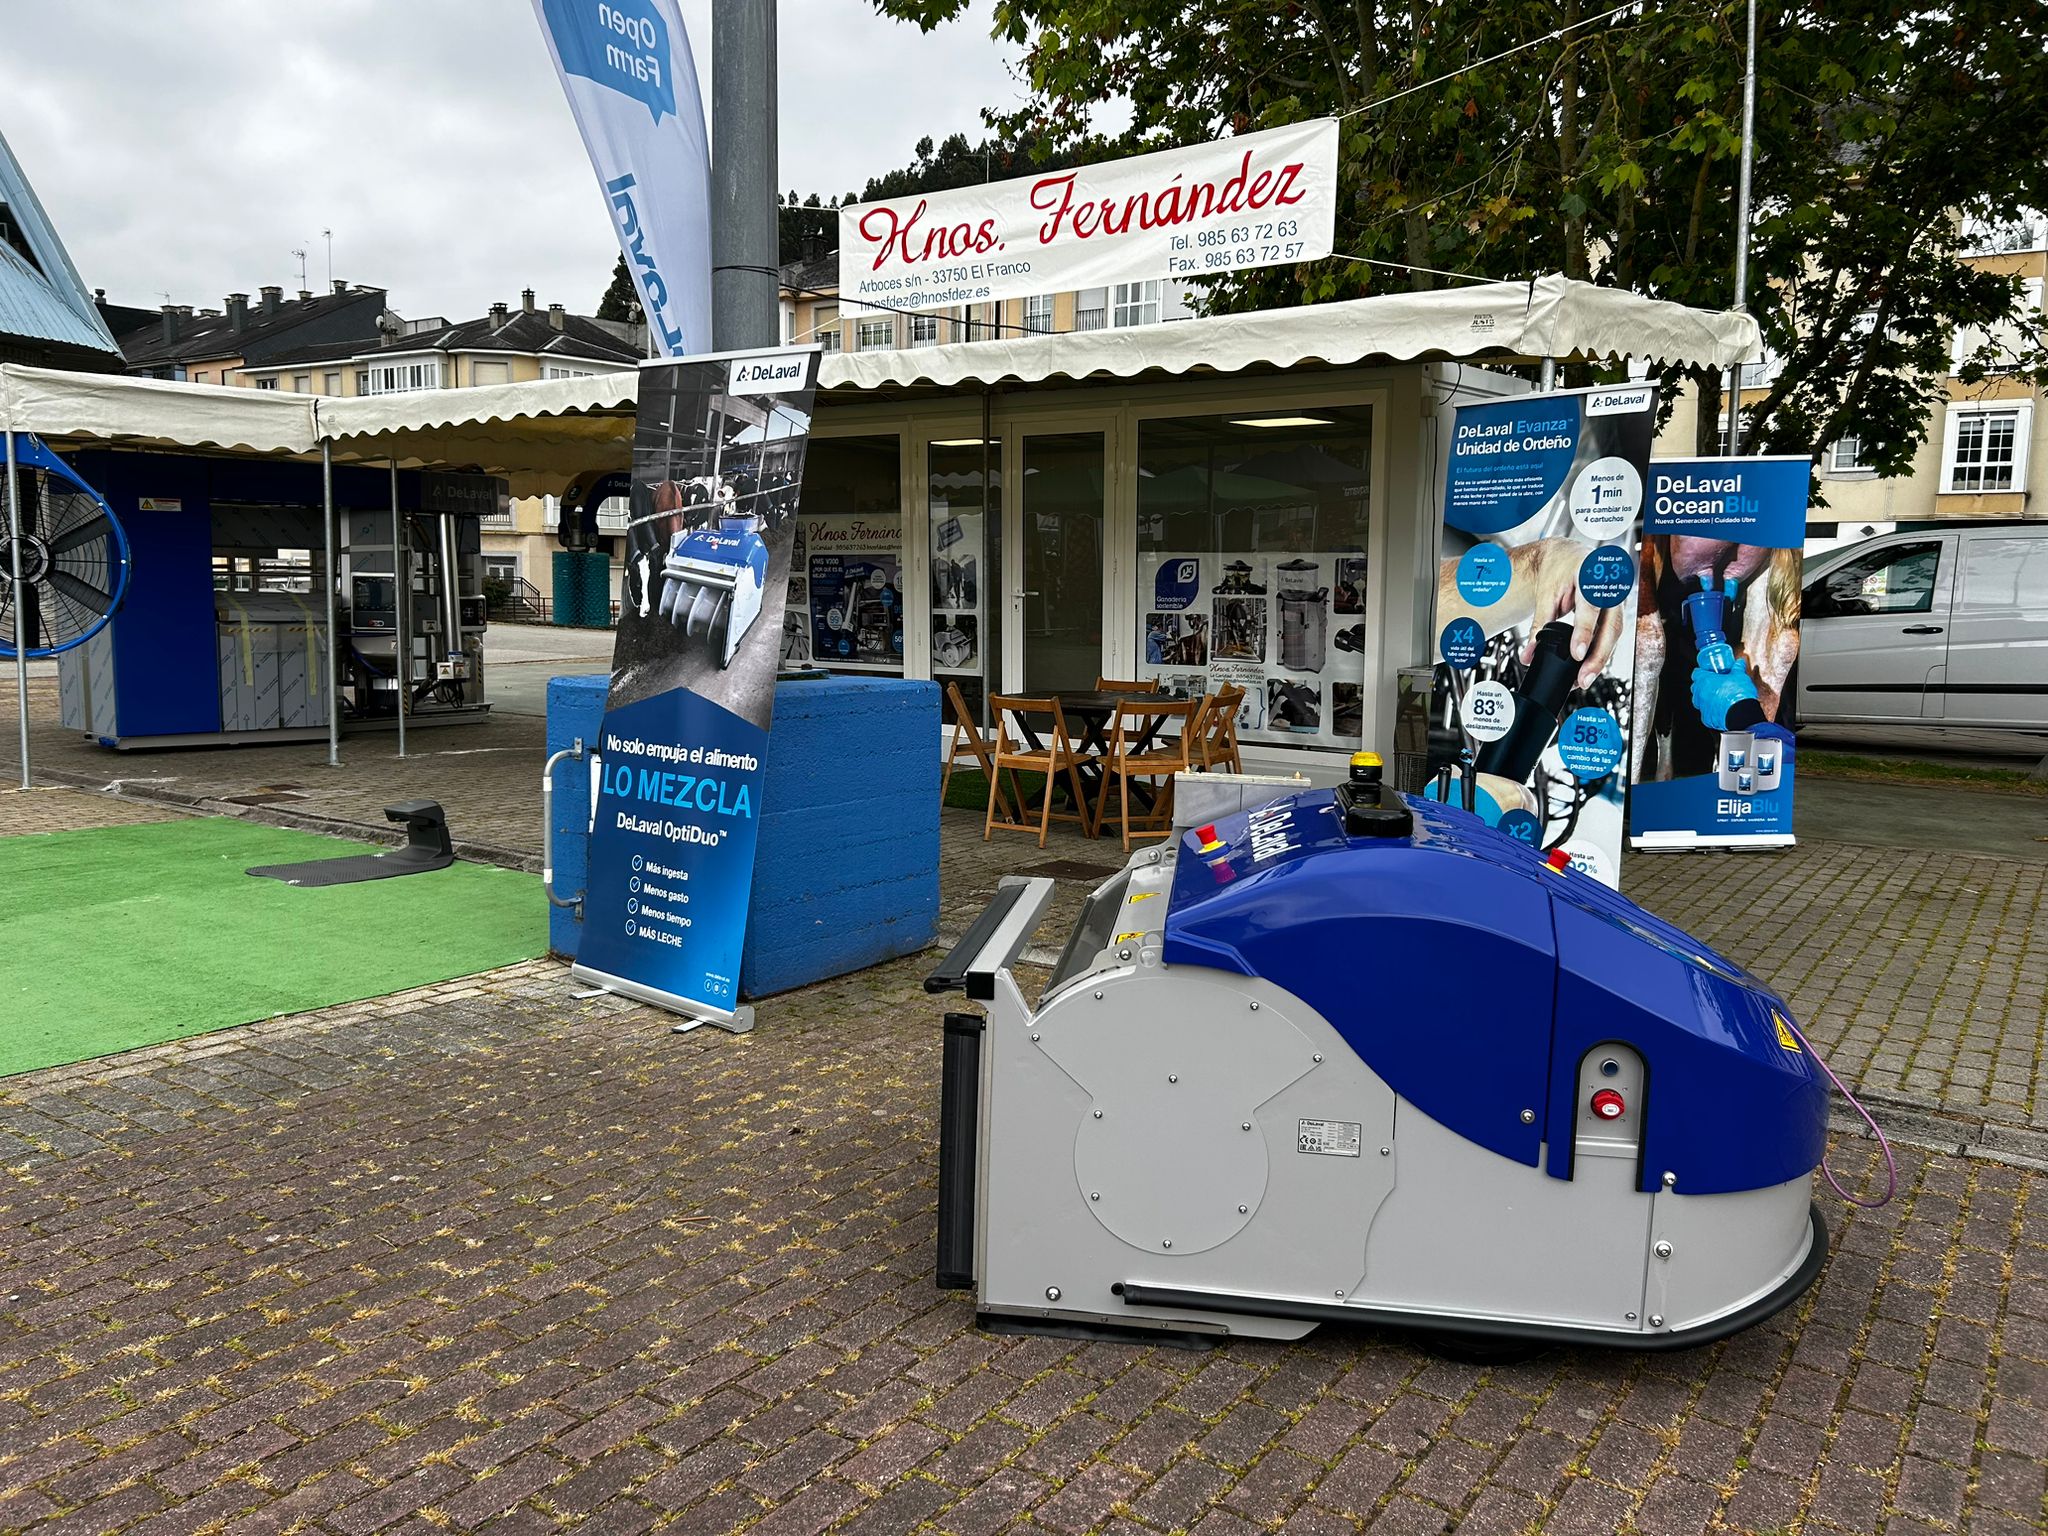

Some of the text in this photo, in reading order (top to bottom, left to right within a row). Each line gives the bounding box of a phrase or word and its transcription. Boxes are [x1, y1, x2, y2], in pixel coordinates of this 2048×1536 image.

[859, 149, 1307, 271] Hnos. Fernández
[1170, 220, 1297, 250] Tel. 985 63 72 63
[1169, 242, 1304, 272] Fax. 985 63 72 57
[859, 280, 903, 293] Arboces
[905, 273, 922, 288] s/n
[933, 267, 968, 284] 33750
[972, 265, 983, 279] El
[987, 262, 1031, 277] Franco
[752, 362, 801, 381] DeLaval
[1605, 394, 1645, 407] DeLaval
[1458, 421, 1513, 439] DeLaval
[1456, 435, 1572, 456] Unidad de Ordeño
[447, 486, 492, 500] DeLaval
[1656, 475, 1742, 494] DeLaval
[1592, 485, 1622, 505] 1 min
[1576, 507, 1591, 515] para
[1655, 496, 1759, 515] OceanBlu
[1452, 626, 1474, 644] x4
[1474, 699, 1504, 716] 83%
[1578, 715, 1597, 723] Hasta
[1574, 725, 1609, 745] 58%
[607, 734, 758, 772] No solo empuja el alimento
[1585, 746, 1608, 755] tiempo
[603, 764, 752, 819] LO MEZCLA
[1717, 799, 1779, 818] ElijaBlu
[617, 812, 663, 837] DeLaval
[1509, 821, 1532, 841] x2
[1250, 812, 1302, 863] DeLaval
[646, 861, 689, 881] Más ingesta
[644, 883, 690, 904] Menos gasto
[642, 905, 692, 928] Menos tiempo
[639, 926, 683, 948] MÁS LECHE
